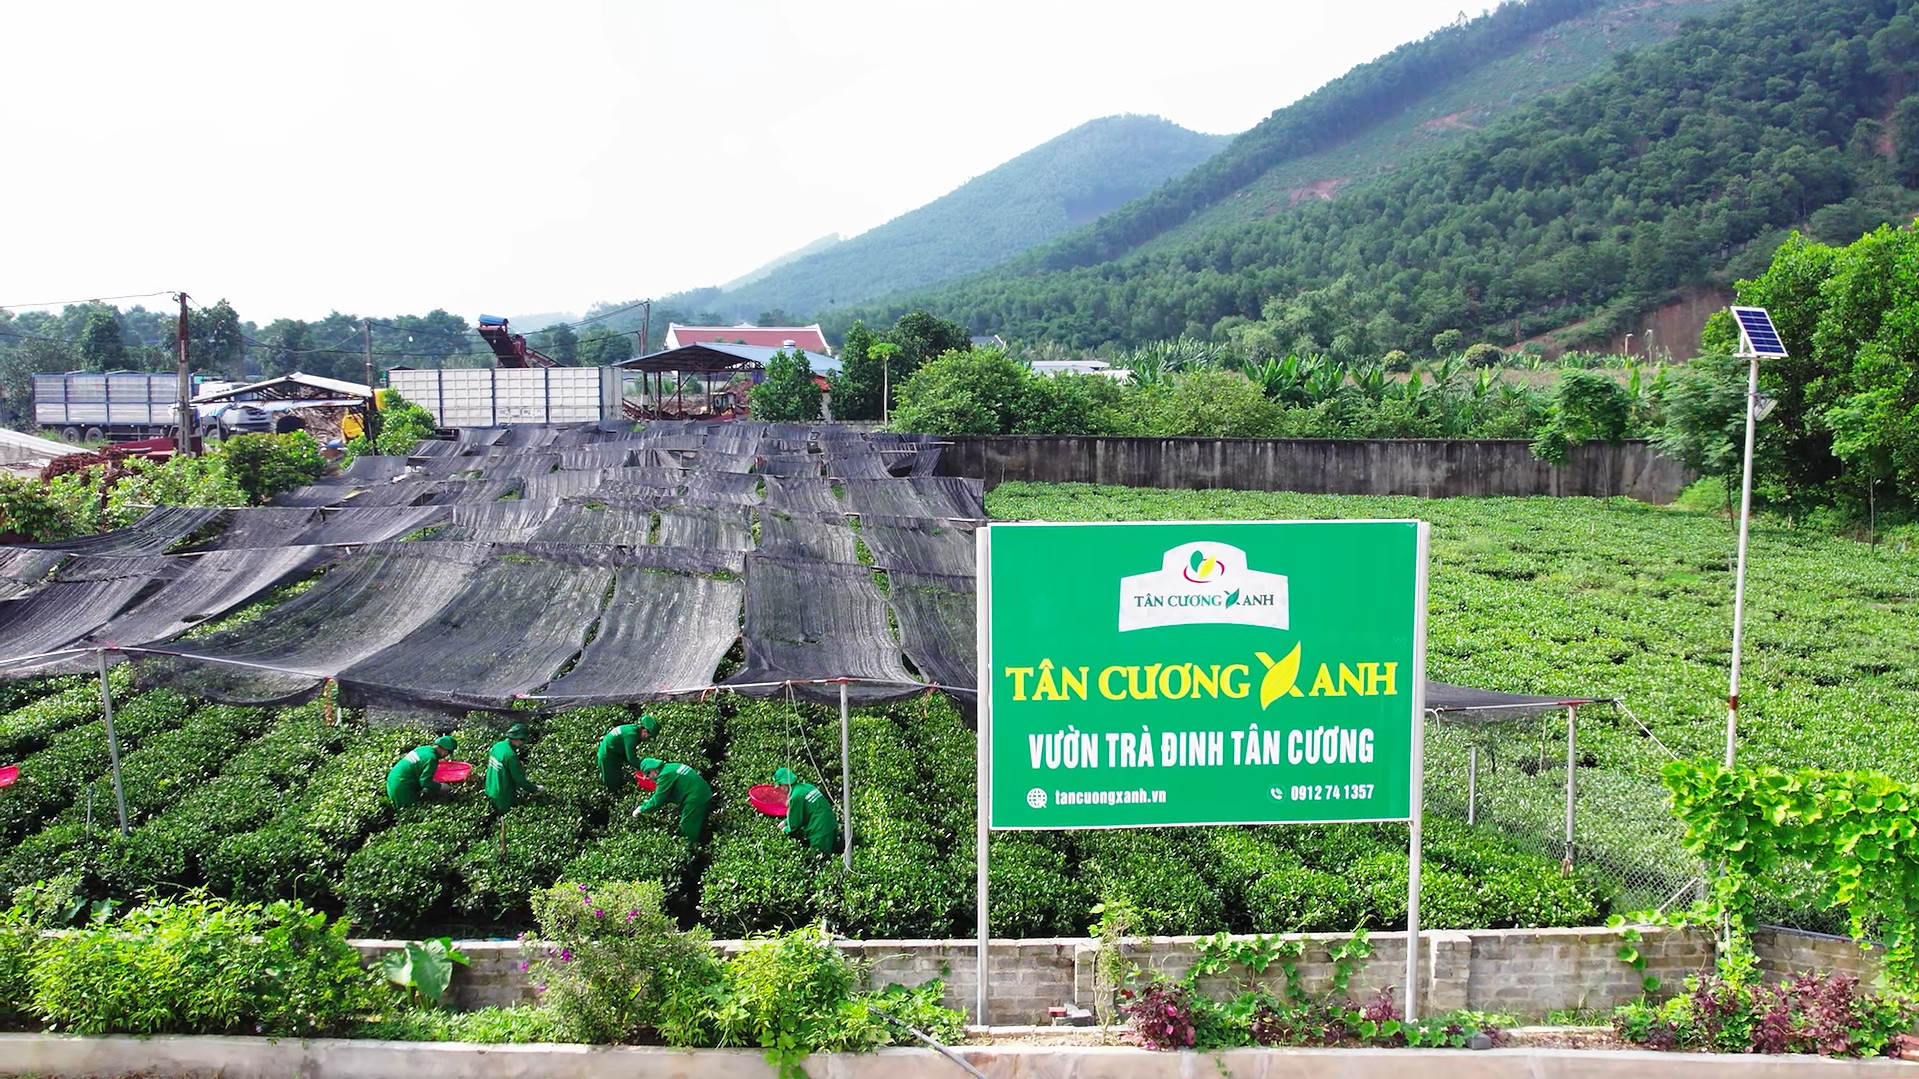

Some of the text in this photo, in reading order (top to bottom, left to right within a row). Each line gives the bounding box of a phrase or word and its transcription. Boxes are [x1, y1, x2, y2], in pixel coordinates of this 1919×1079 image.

[1134, 593, 1164, 607] TÂN
[1167, 593, 1222, 607] CƯƠNG
[1005, 657, 1090, 701] TÂN
[1098, 662, 1251, 700] CƯƠNG
[1028, 723, 1375, 769] VƯỜN TRÀ ĐINH TÂN CƯƠNG
[1055, 788, 1167, 806] tancuongxanh.vn
[1290, 784, 1375, 801] 0912 74 1357
